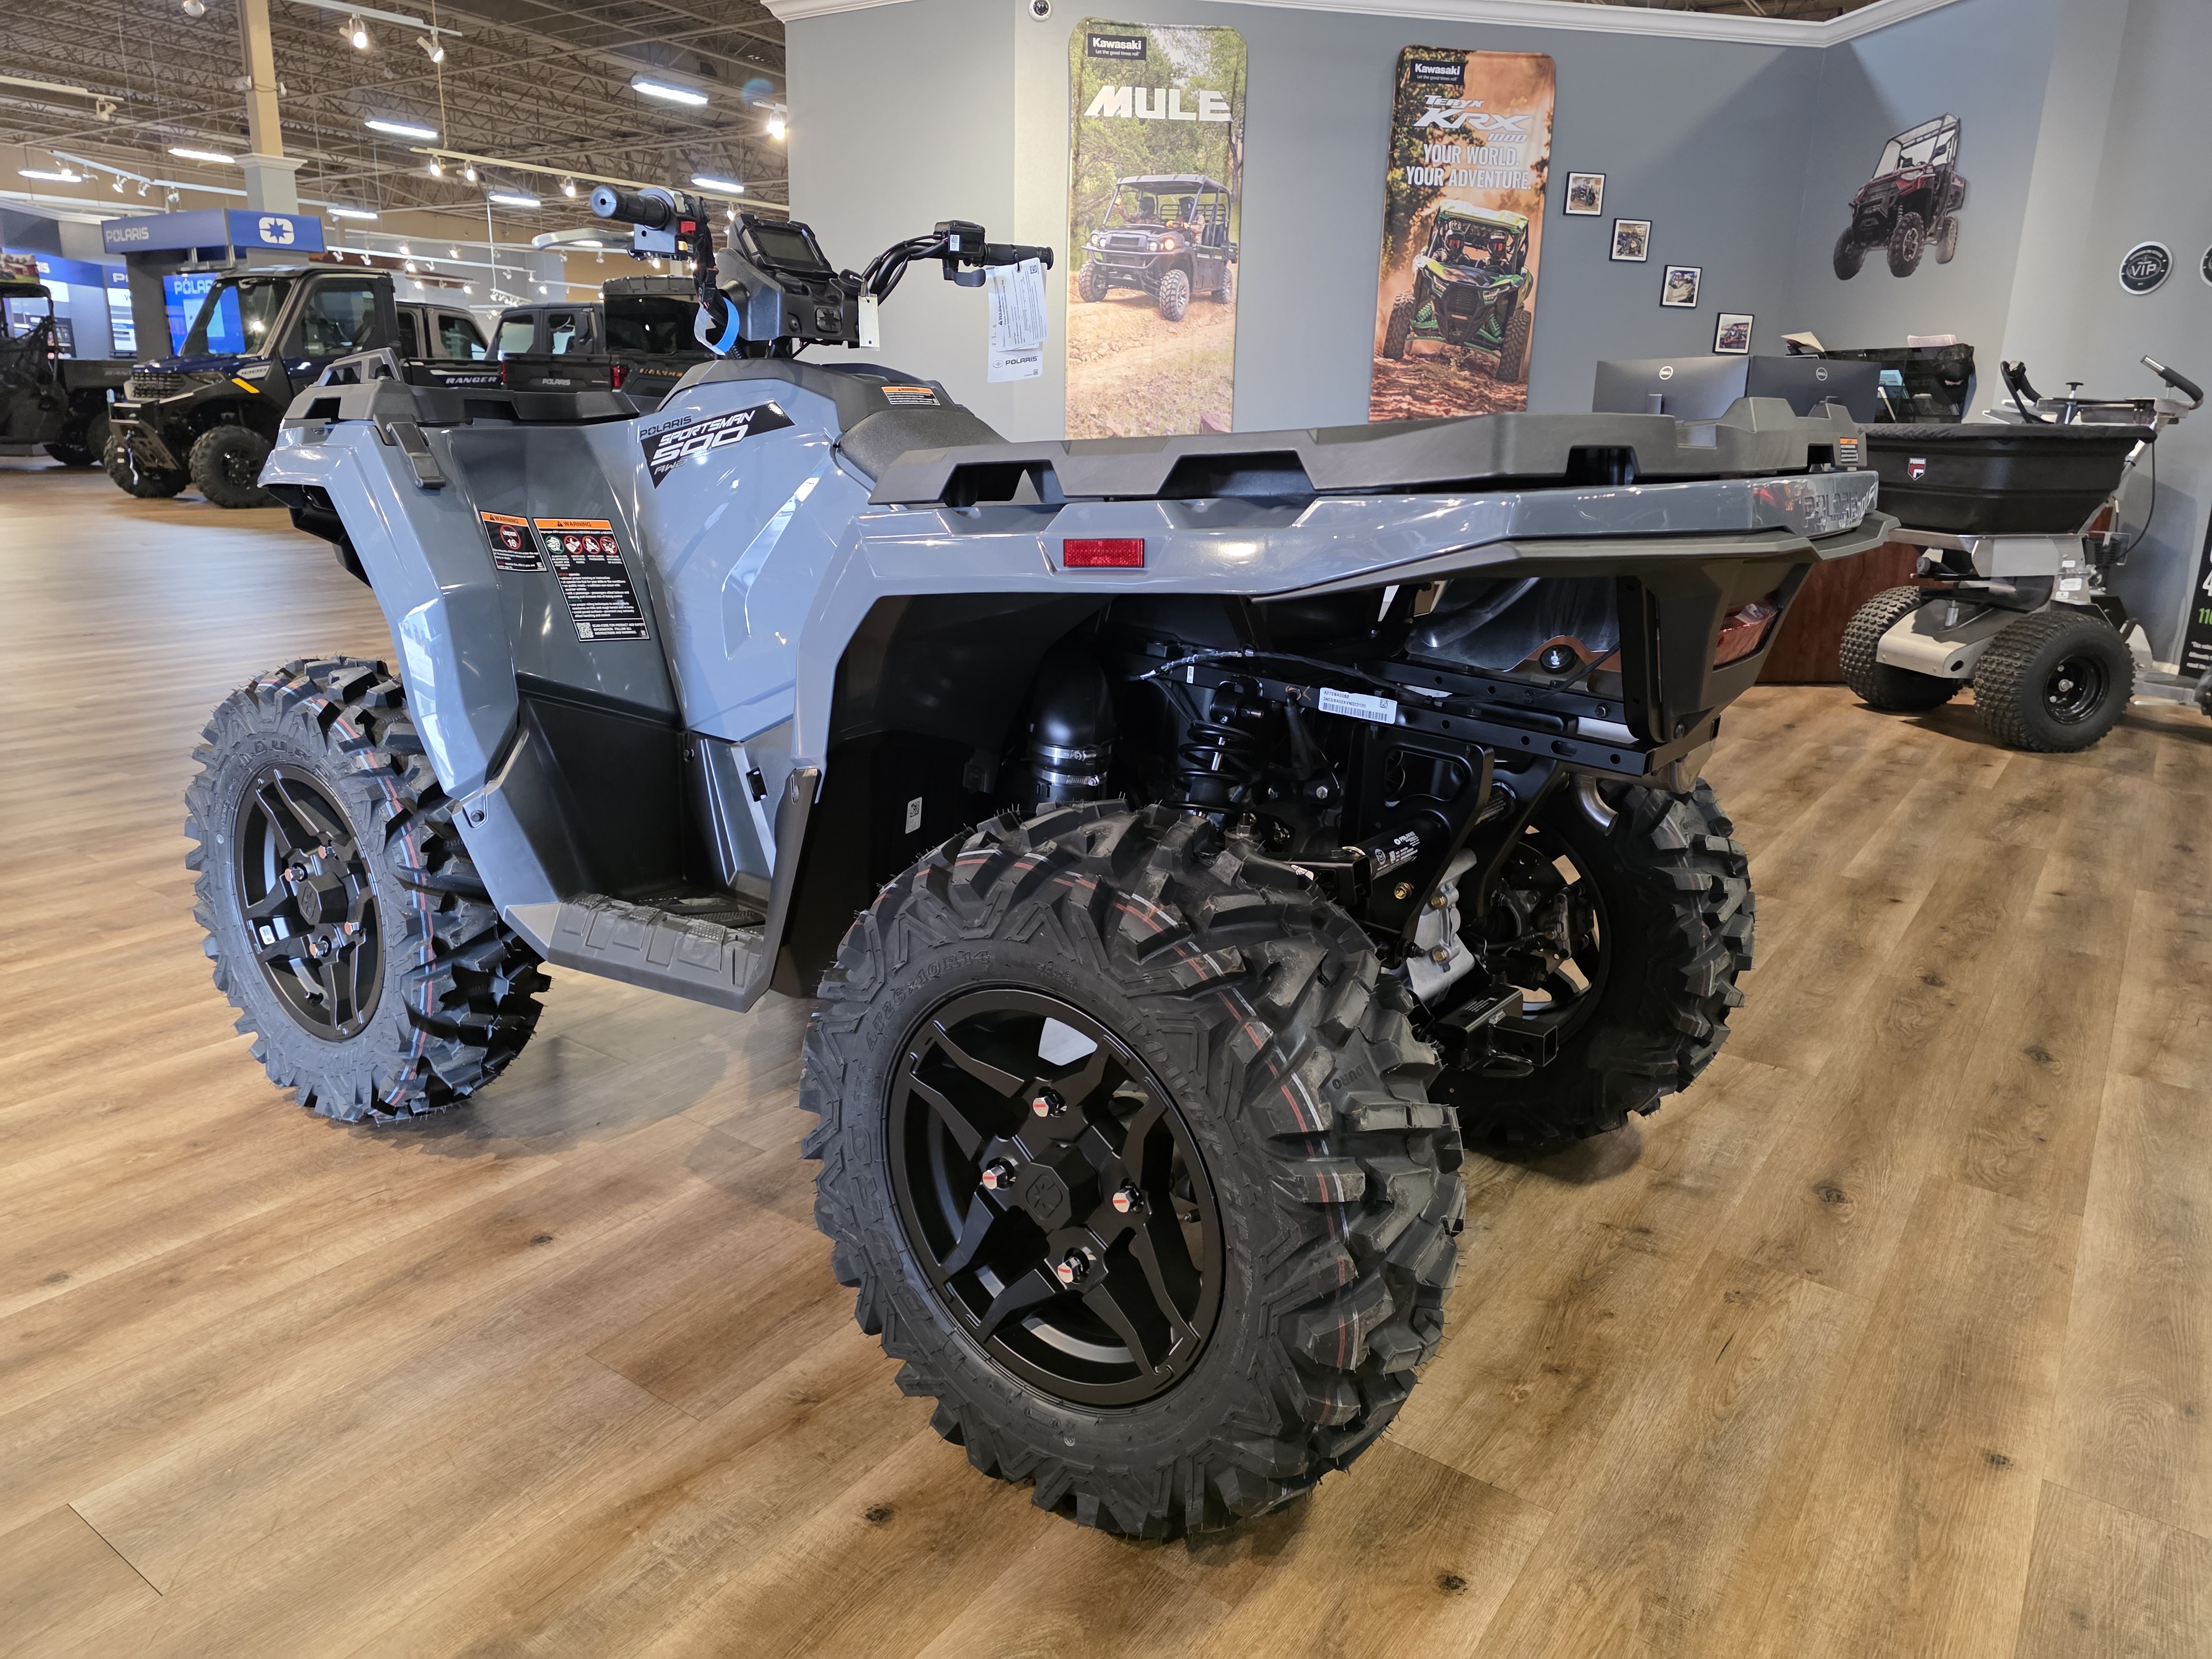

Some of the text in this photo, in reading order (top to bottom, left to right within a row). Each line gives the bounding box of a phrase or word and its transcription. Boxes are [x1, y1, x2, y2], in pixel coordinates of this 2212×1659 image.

[1093, 38, 1141, 50] Kawasaki
[1415, 63, 1460, 76] Kawasaki
[1084, 85, 1233, 122] MULE
[1425, 95, 1484, 108] TERYX
[1413, 107, 1532, 132] KRX
[1488, 133, 1528, 143] 1000
[1423, 144, 1520, 166] YOUR WORLD.
[1406, 166, 1531, 190] YOUR ADVENTURE.
[106, 226, 149, 243] POLARIS
[2131, 264, 2156, 276] VIP
[1005, 356, 1038, 366] POLARIS
[446, 376, 497, 384] RANGER
[640, 415, 691, 439] POLARIS
[658, 410, 755, 447] SPORTSMAN
[650, 424, 748, 467] 500
[654, 458, 687, 475] AWD
[507, 539, 517, 547] 16
